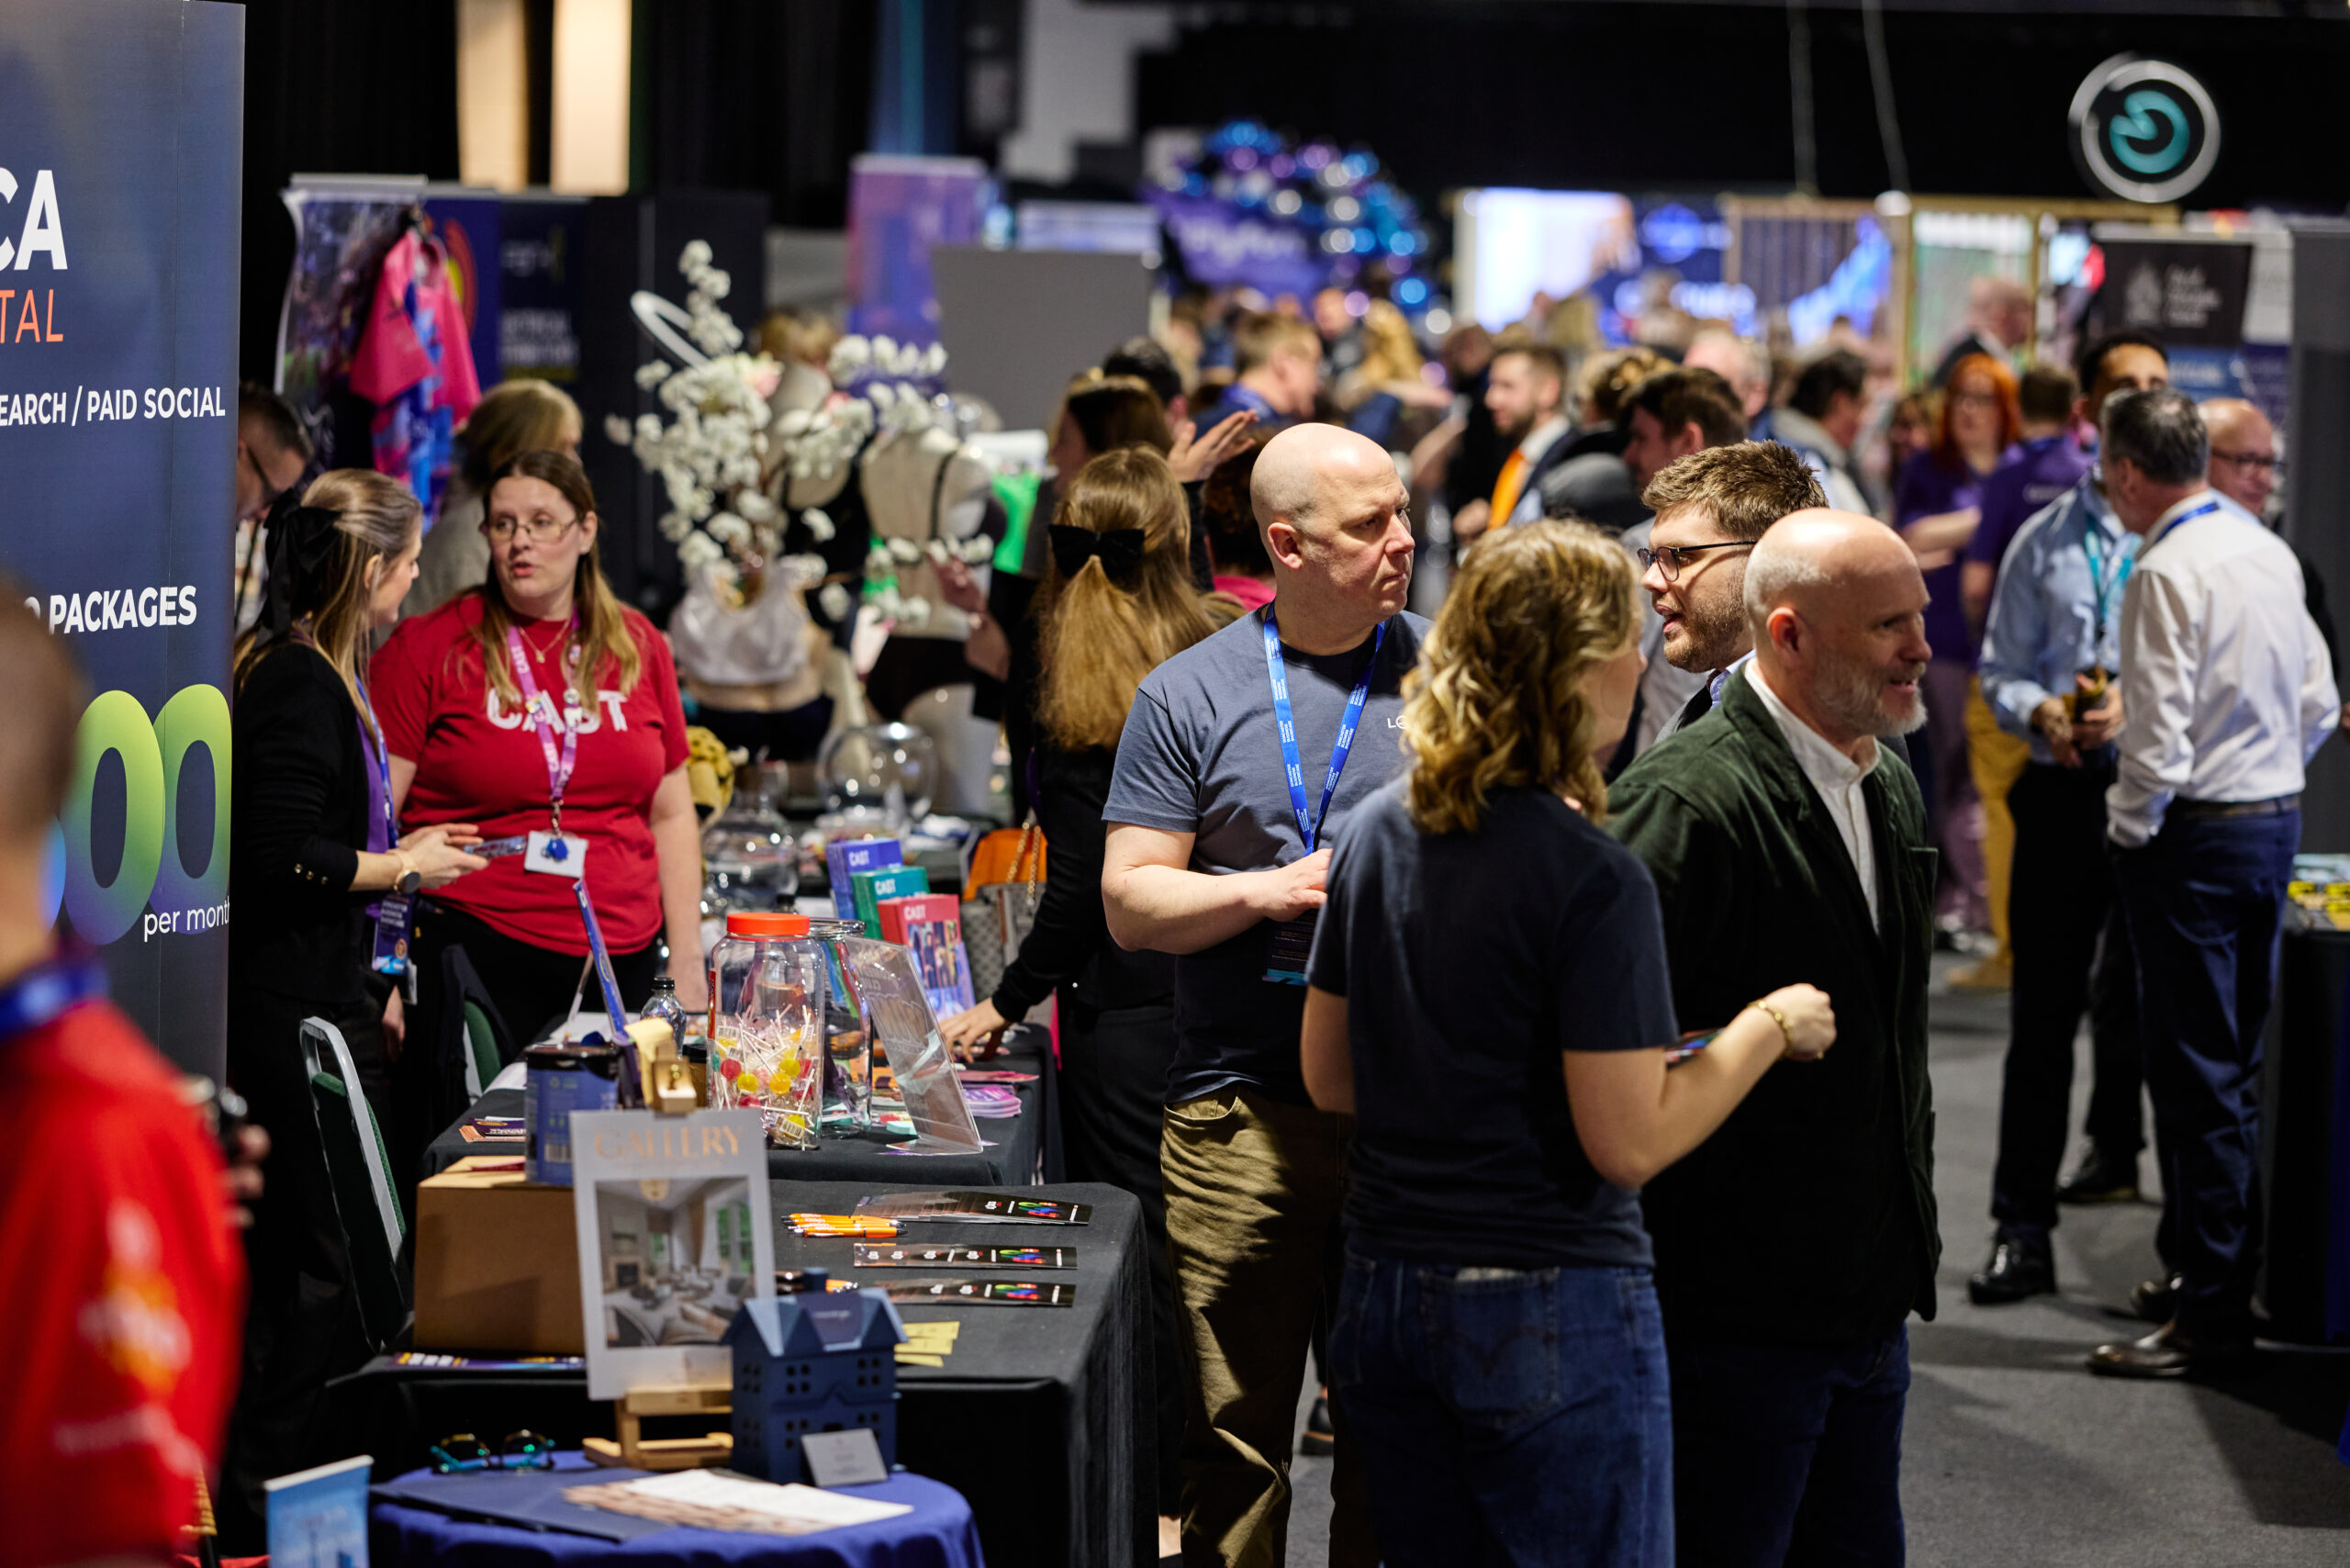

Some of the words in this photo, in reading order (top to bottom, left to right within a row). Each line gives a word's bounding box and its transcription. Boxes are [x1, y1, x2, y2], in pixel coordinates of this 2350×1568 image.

[72, 386, 83, 427] /
[87, 389, 137, 421] PAID
[144, 386, 225, 419] SOCIAL
[49, 585, 197, 633] PACKAGES
[875, 879, 896, 895] CAST
[144, 911, 181, 943] per
[903, 904, 925, 921] CAST
